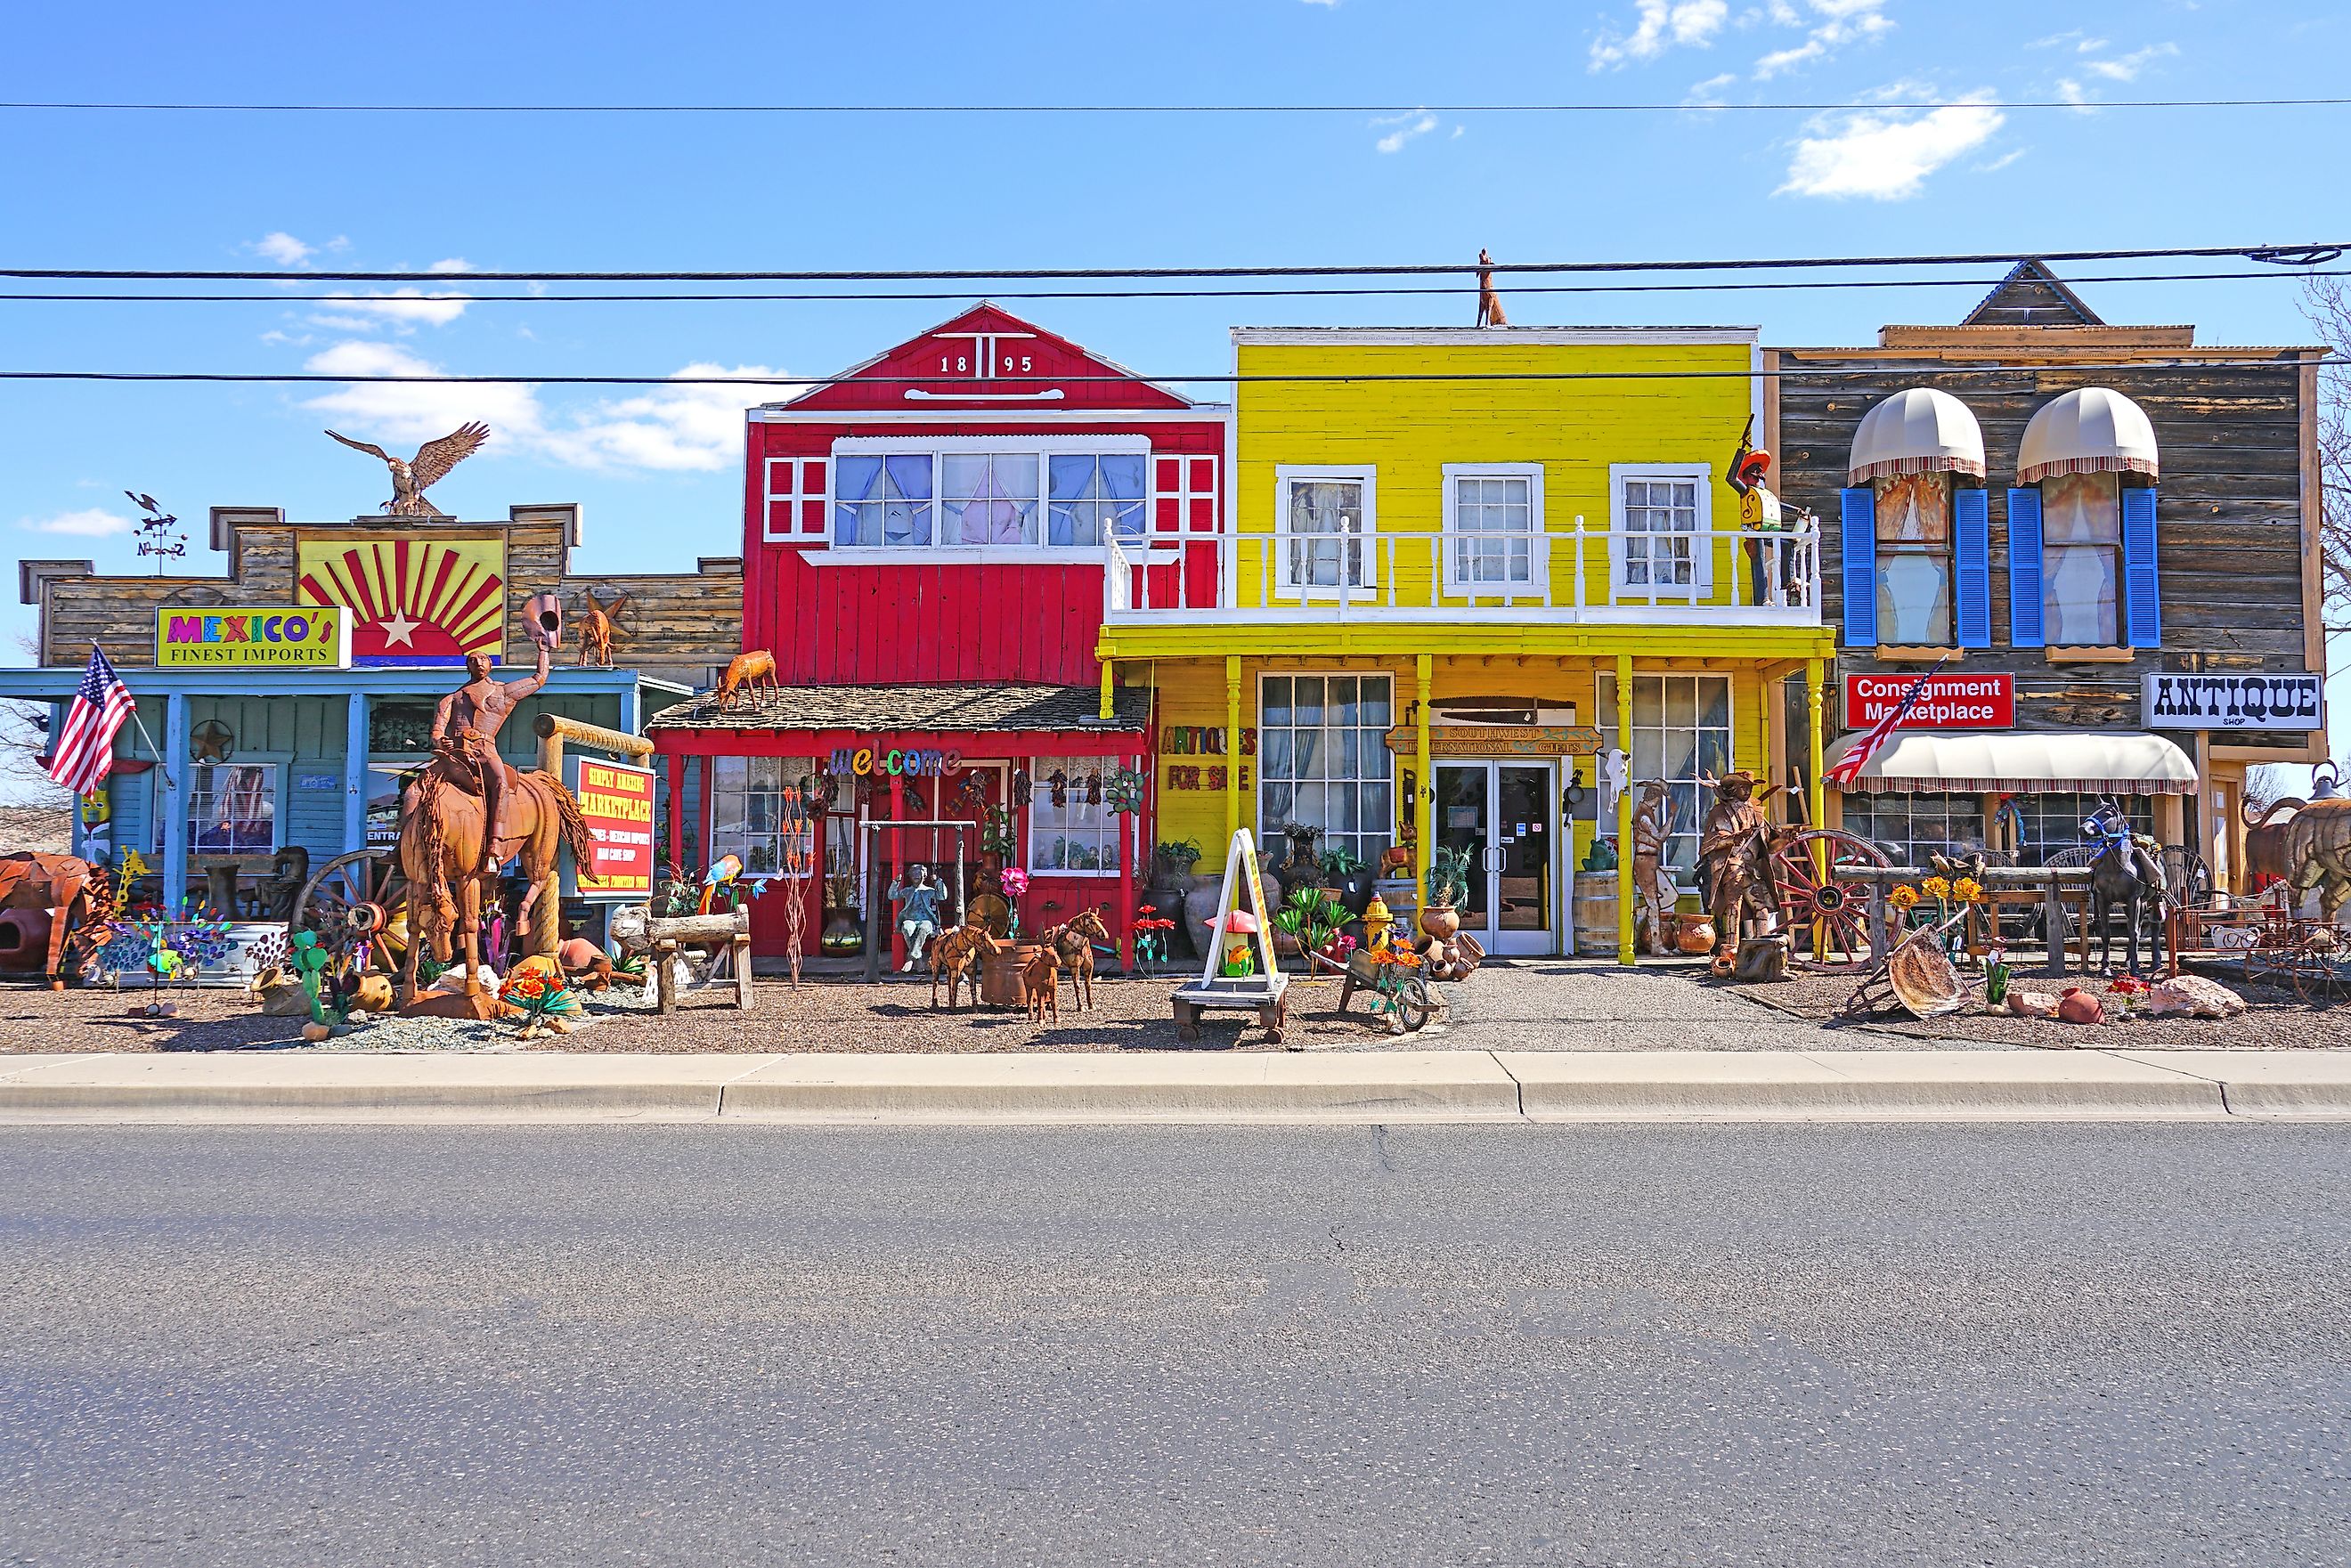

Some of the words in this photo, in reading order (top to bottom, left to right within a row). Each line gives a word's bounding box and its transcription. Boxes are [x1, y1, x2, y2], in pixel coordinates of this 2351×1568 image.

[940, 356, 967, 372] 18
[1004, 356, 1032, 372] 95
[167, 612, 334, 644] MEXICO's
[171, 649, 236, 661] FINEST
[243, 648, 327, 661] IMPORTS
[2154, 678, 2316, 722] ANTIQUE
[1865, 703, 1994, 724] Maketplace
[1449, 728, 1540, 738] SOUTHWEST
[829, 739, 962, 776] welcome
[1408, 742, 1512, 752] IERNATIONAL
[1539, 743, 1581, 752] GIFTS
[1168, 766, 1200, 790] FOR
[1208, 766, 1249, 790] SAE
[580, 791, 651, 823] MARKETPLACE
